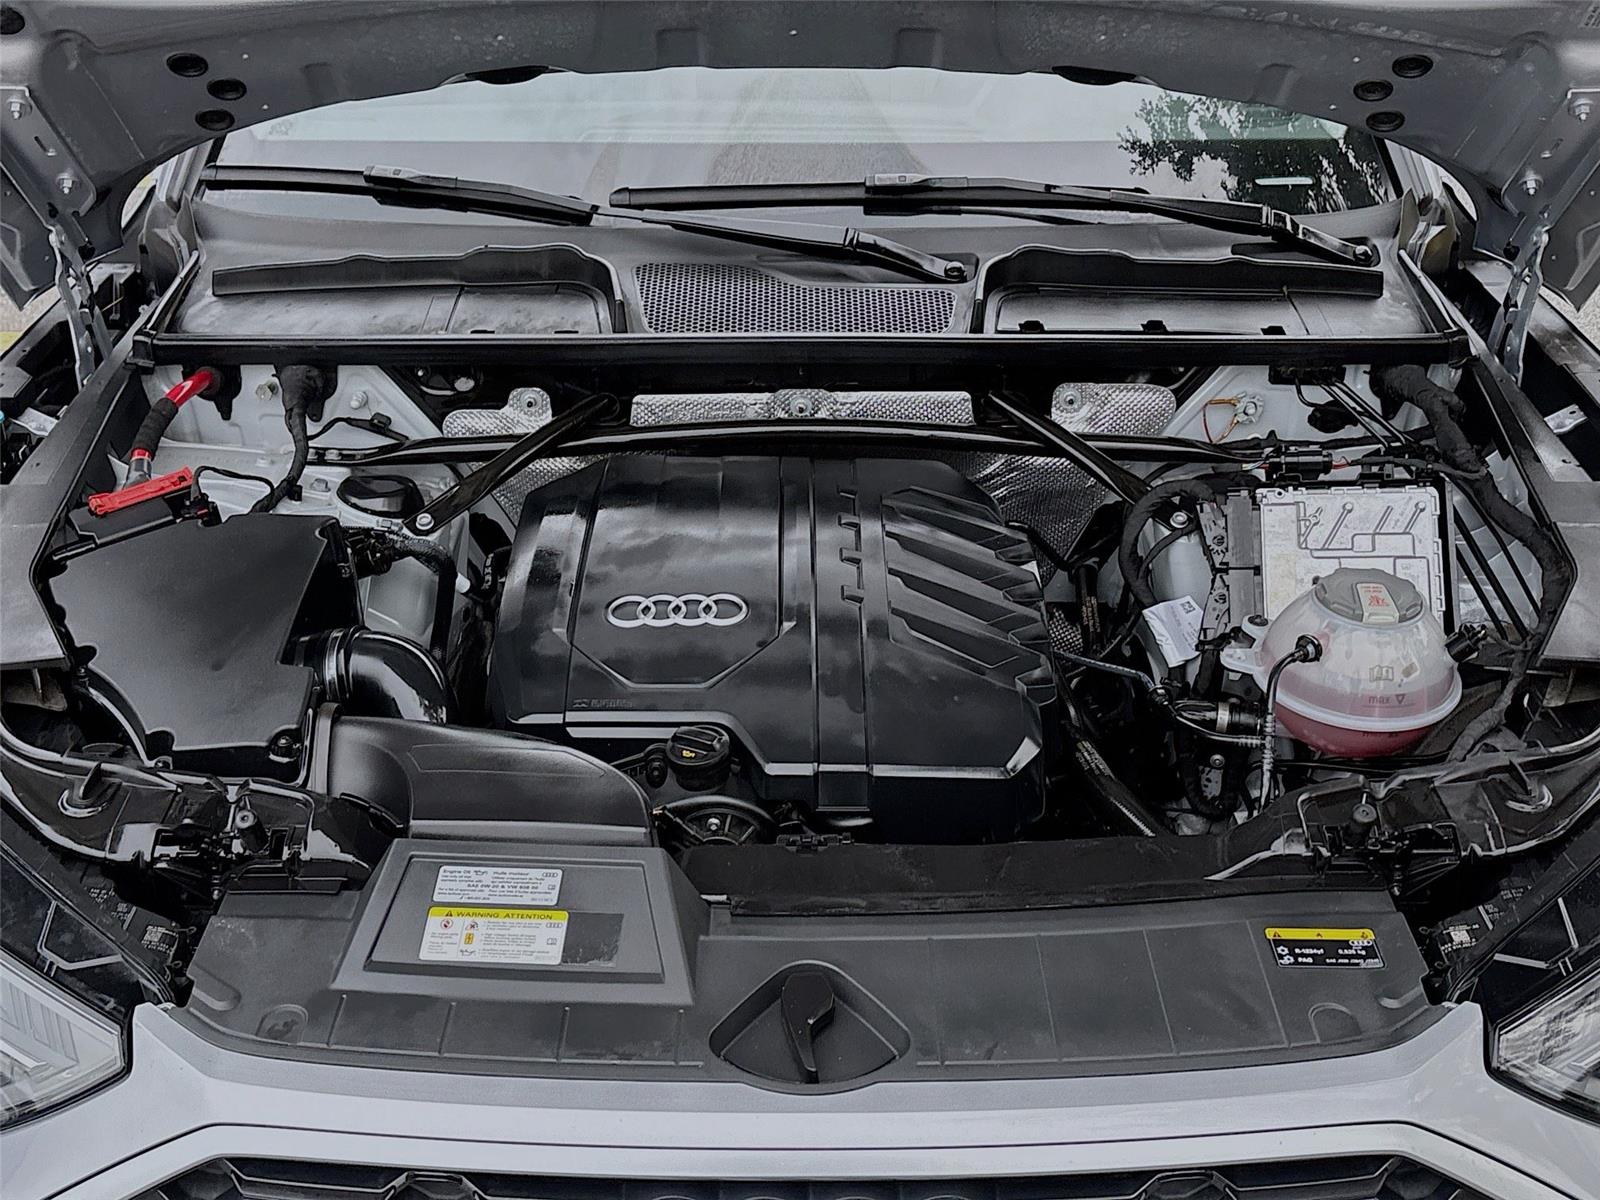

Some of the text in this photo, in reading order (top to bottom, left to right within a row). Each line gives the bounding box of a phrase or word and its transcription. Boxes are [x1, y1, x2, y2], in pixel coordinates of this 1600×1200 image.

[1368, 695, 1390, 705] max
[456, 910, 553, 920] WARNING ATTENTION
